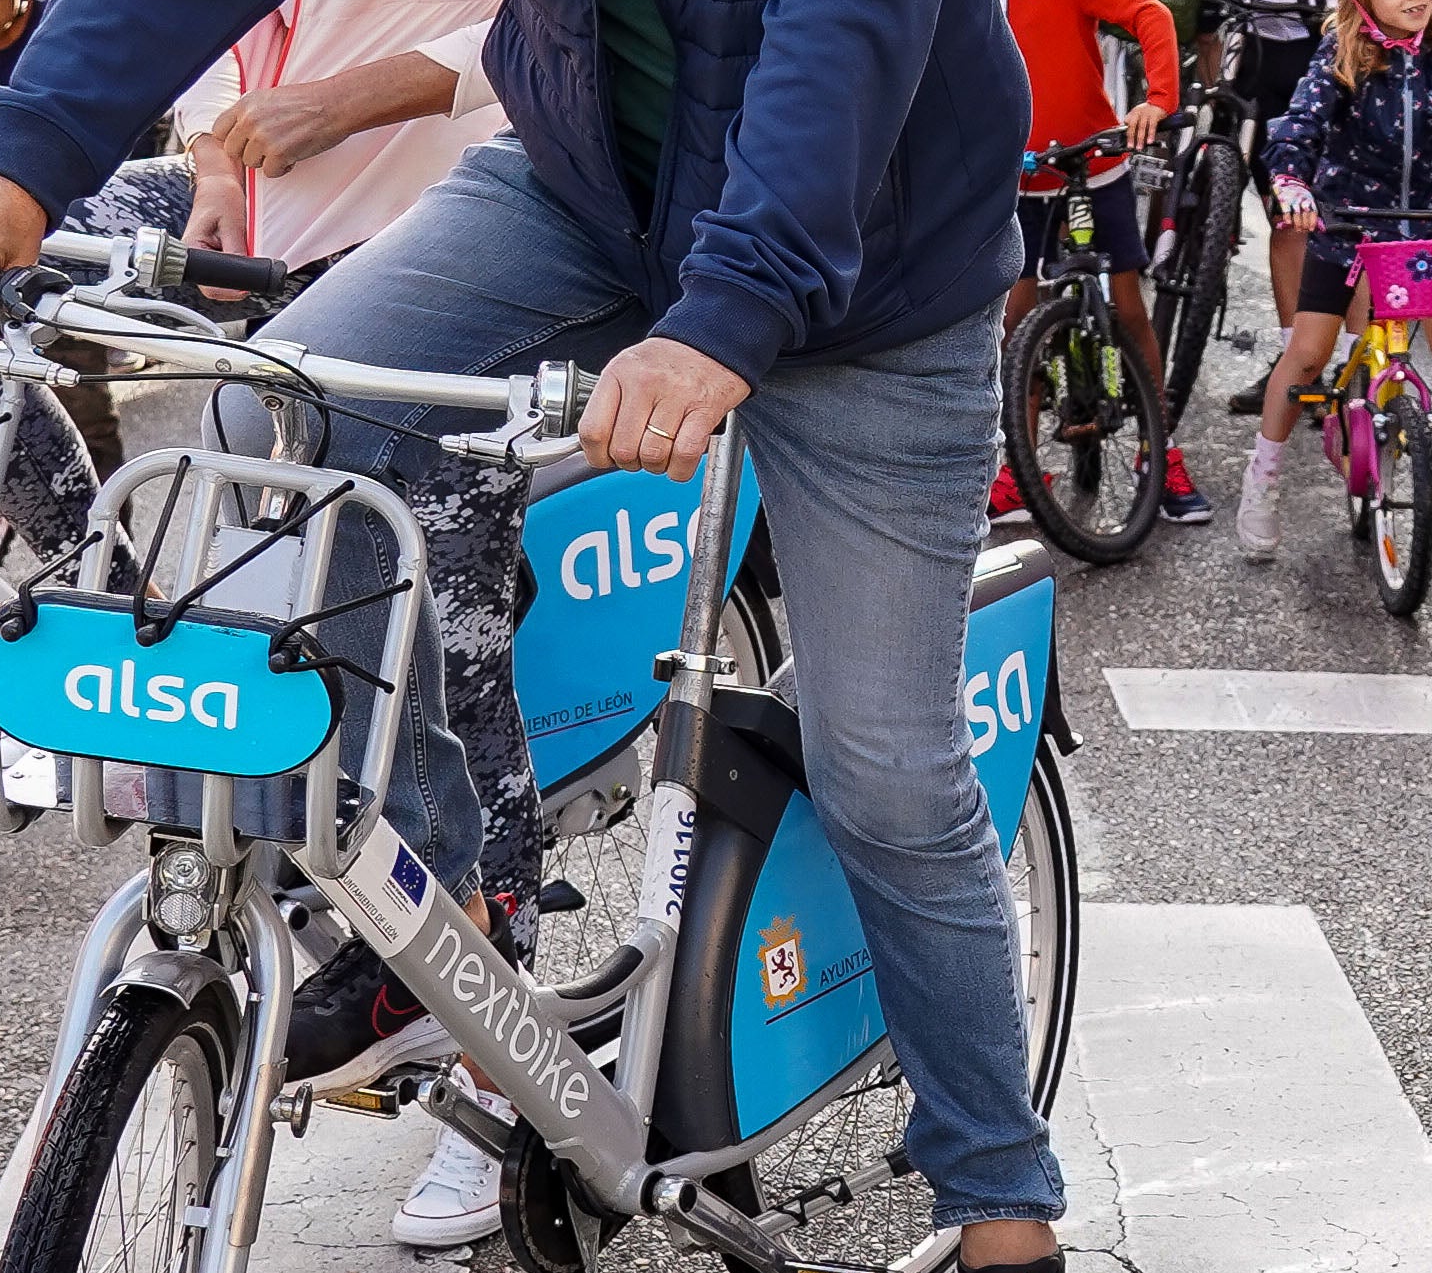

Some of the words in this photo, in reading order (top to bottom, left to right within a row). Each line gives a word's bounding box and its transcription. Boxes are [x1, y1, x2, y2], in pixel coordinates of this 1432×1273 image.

[560, 506, 702, 601] als
[64, 659, 240, 731] alsa
[574, 702, 594, 720] DE
[597, 689, 633, 714] LEÓN
[965, 650, 1034, 759] sa
[665, 810, 698, 917] 240116
[819, 947, 872, 988] AYUNTA
[424, 922, 591, 1119] nextbike
